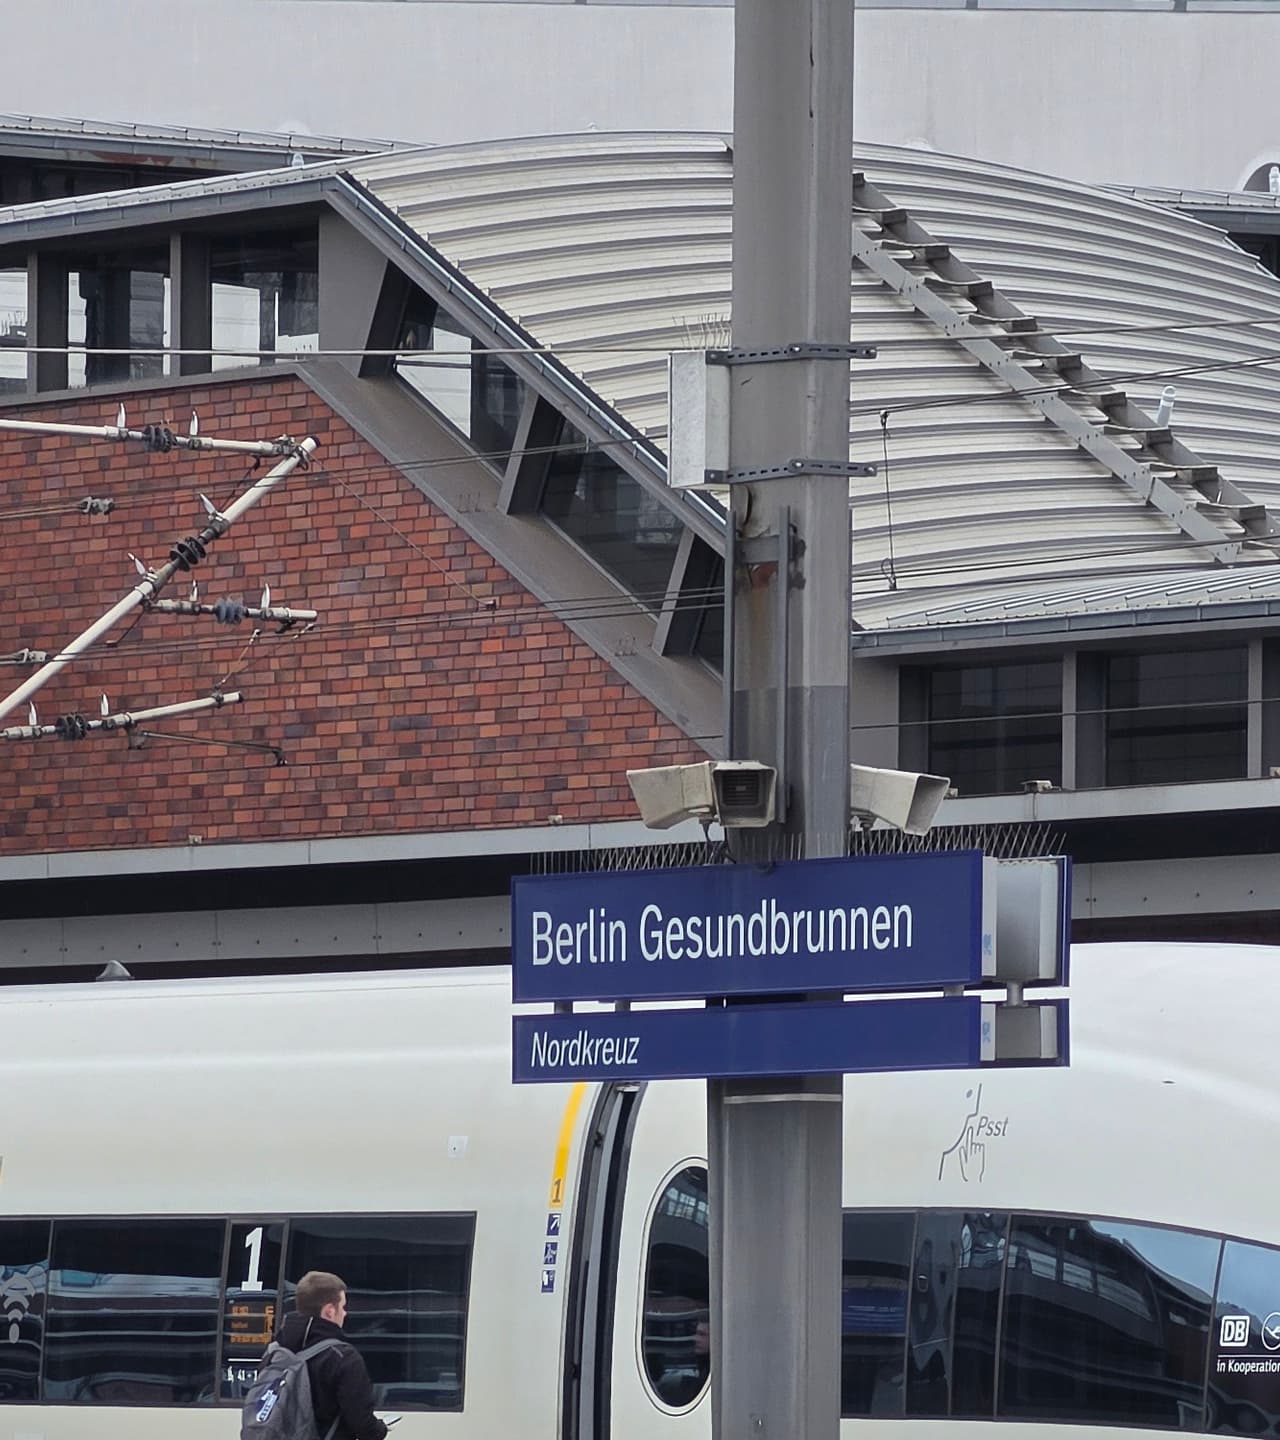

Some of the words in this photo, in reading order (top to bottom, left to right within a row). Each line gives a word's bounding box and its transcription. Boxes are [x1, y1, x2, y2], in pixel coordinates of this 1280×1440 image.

[532, 907, 627, 966] Berlin
[639, 898, 913, 962] Gesundbrunnen
[531, 1029, 640, 1067] Nordkreuz
[976, 1116, 1009, 1136] Psst
[552, 1178, 562, 1203] 1
[241, 1227, 263, 1291] 1
[1223, 1319, 1247, 1343] DB
[1216, 1359, 1226, 1373] in
